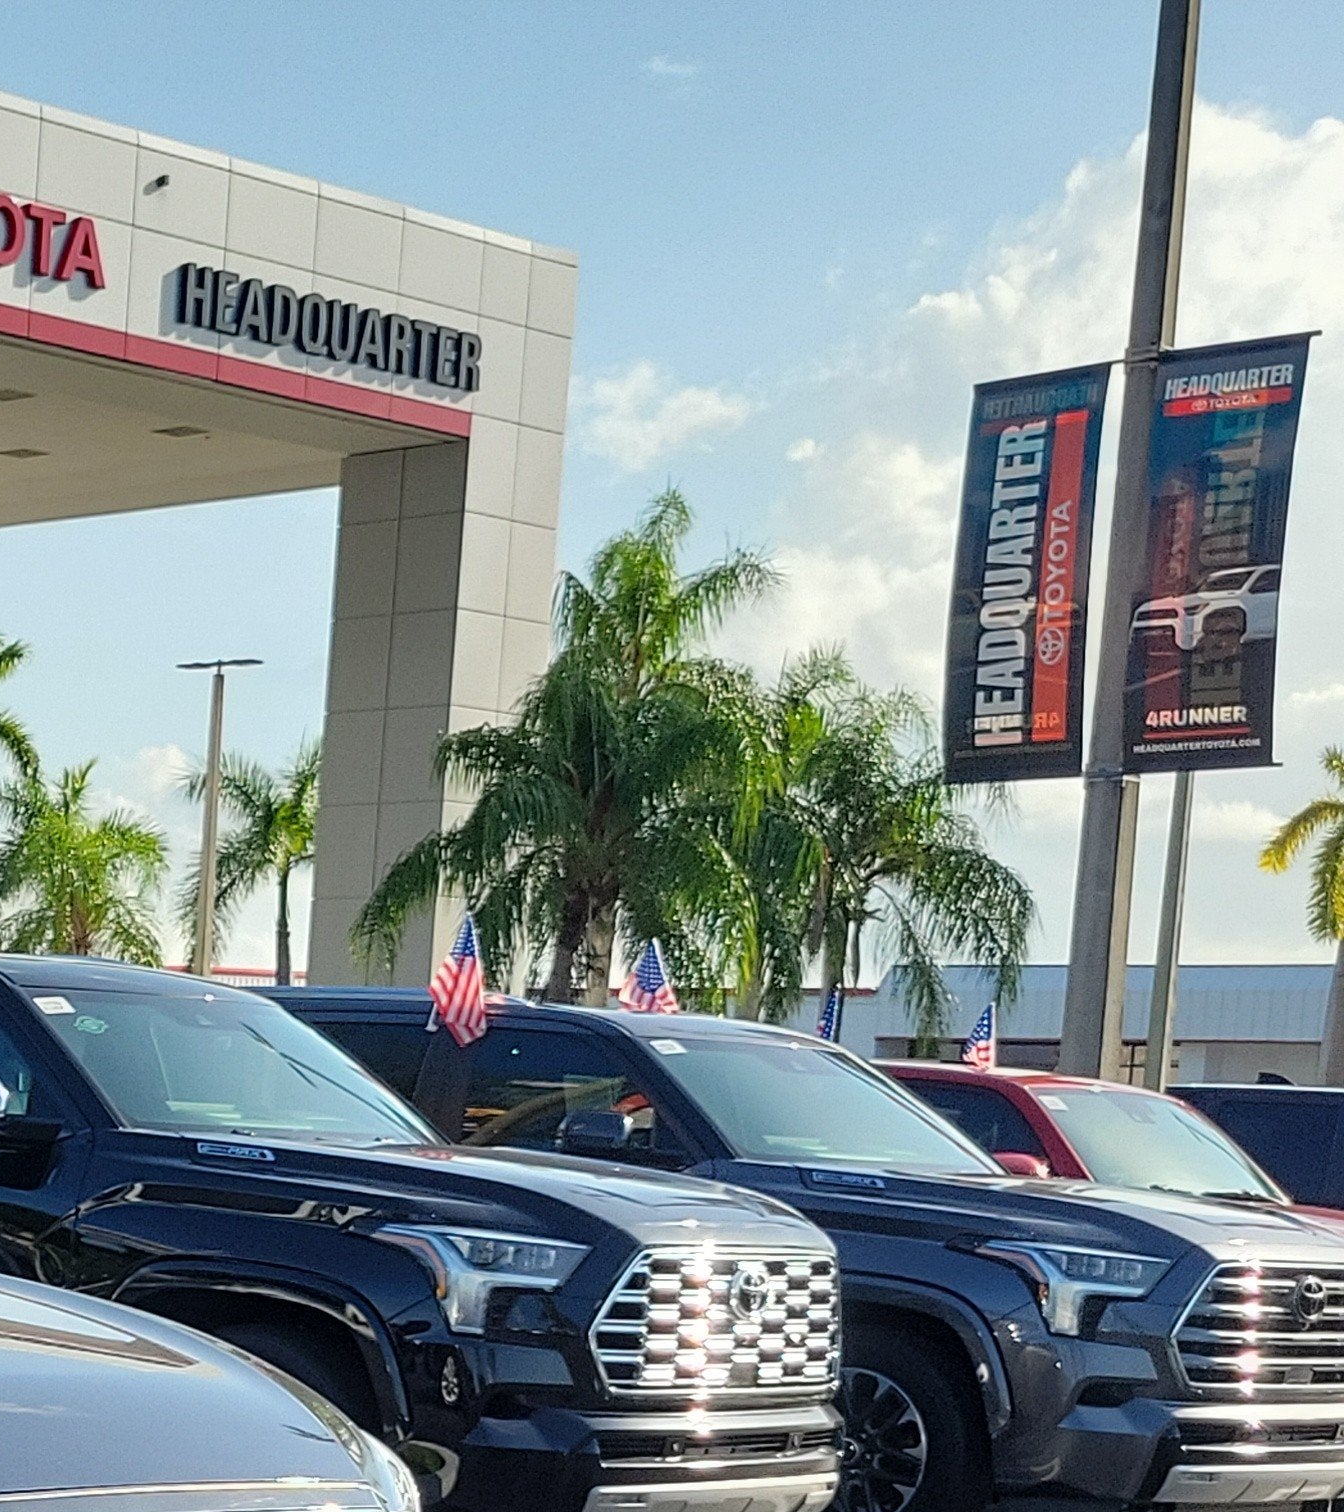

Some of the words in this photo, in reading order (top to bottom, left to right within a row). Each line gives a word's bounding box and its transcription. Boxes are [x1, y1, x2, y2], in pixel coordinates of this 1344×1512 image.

[174, 263, 482, 392] HEADQUARTER
[1164, 364, 1293, 400] HEADQUARTER
[1209, 394, 1257, 408] TOYOTA
[1043, 499, 1073, 622] TOYOTA
[974, 419, 1047, 747] HEADQUARTER
[1145, 705, 1248, 729] 4RUNNER
[1132, 738, 1261, 754] HEADQUARTERTOYOTA.COM
